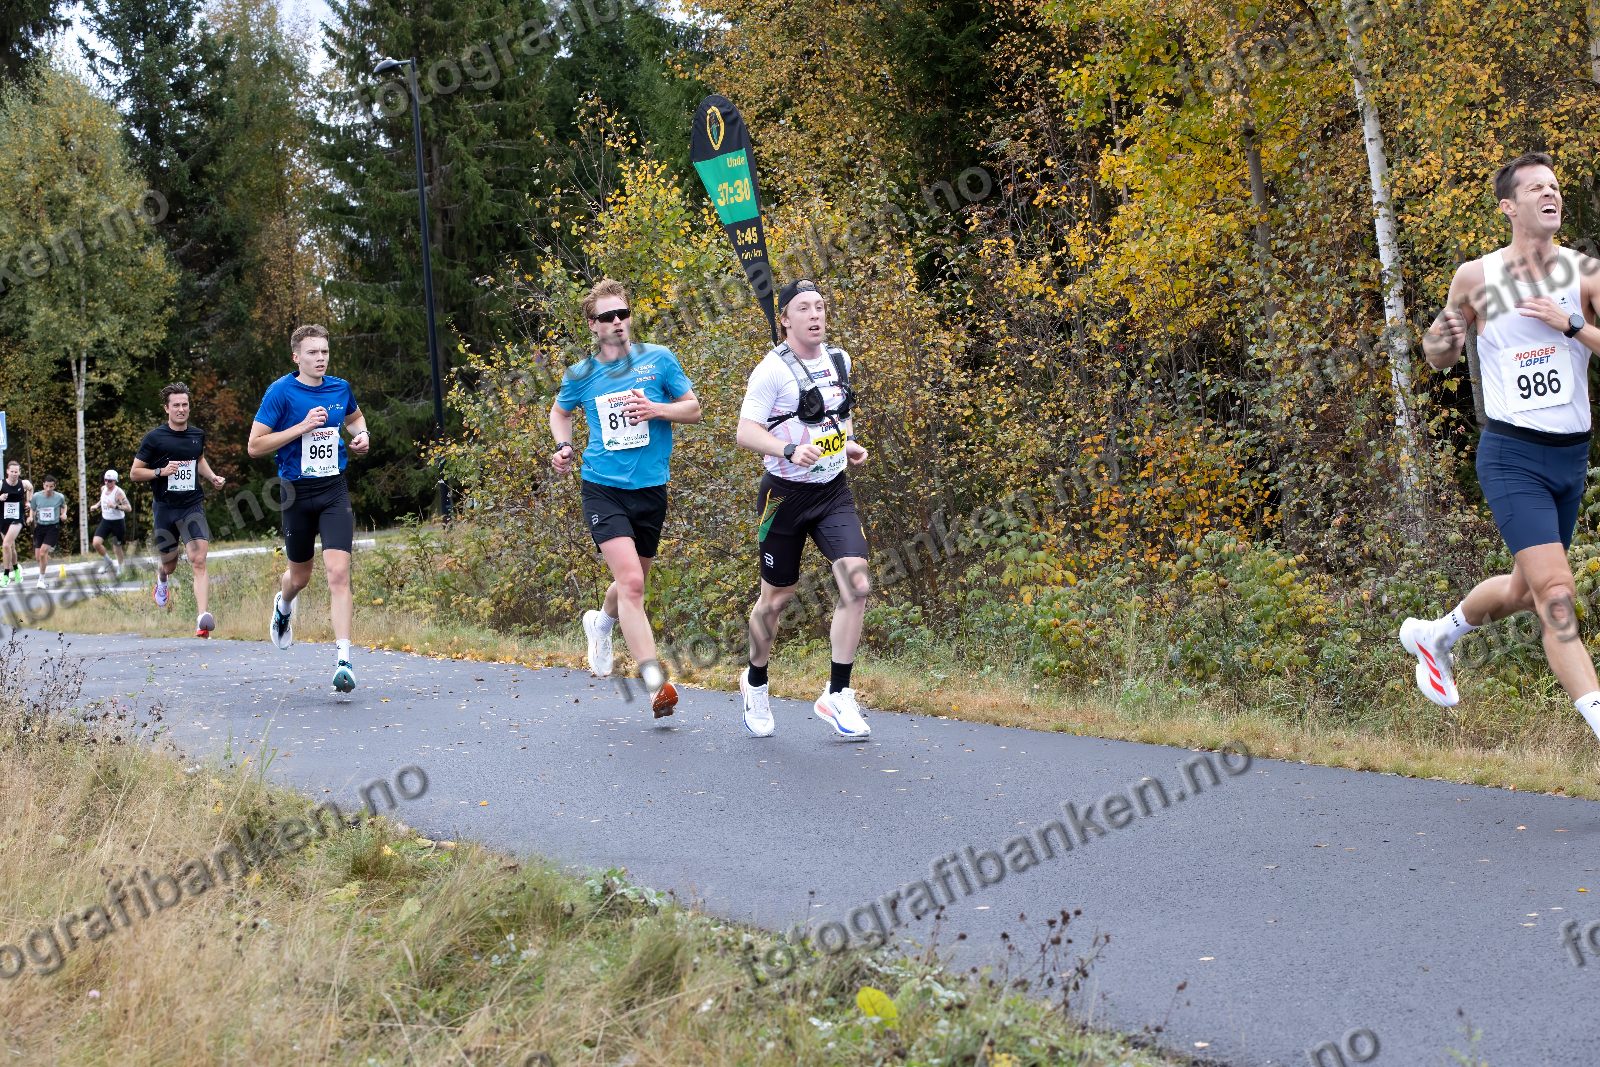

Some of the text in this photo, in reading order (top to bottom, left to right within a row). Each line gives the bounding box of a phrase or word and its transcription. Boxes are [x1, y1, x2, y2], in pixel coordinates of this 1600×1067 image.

[717, 177, 751, 207] 37:30
[736, 227, 758, 246] 3:45
[1514, 346, 1556, 361] NORGES
[1519, 355, 1551, 368] LØPET
[1517, 369, 1561, 399] 986
[309, 444, 333, 459] 965
[174, 469, 192, 481] 985
